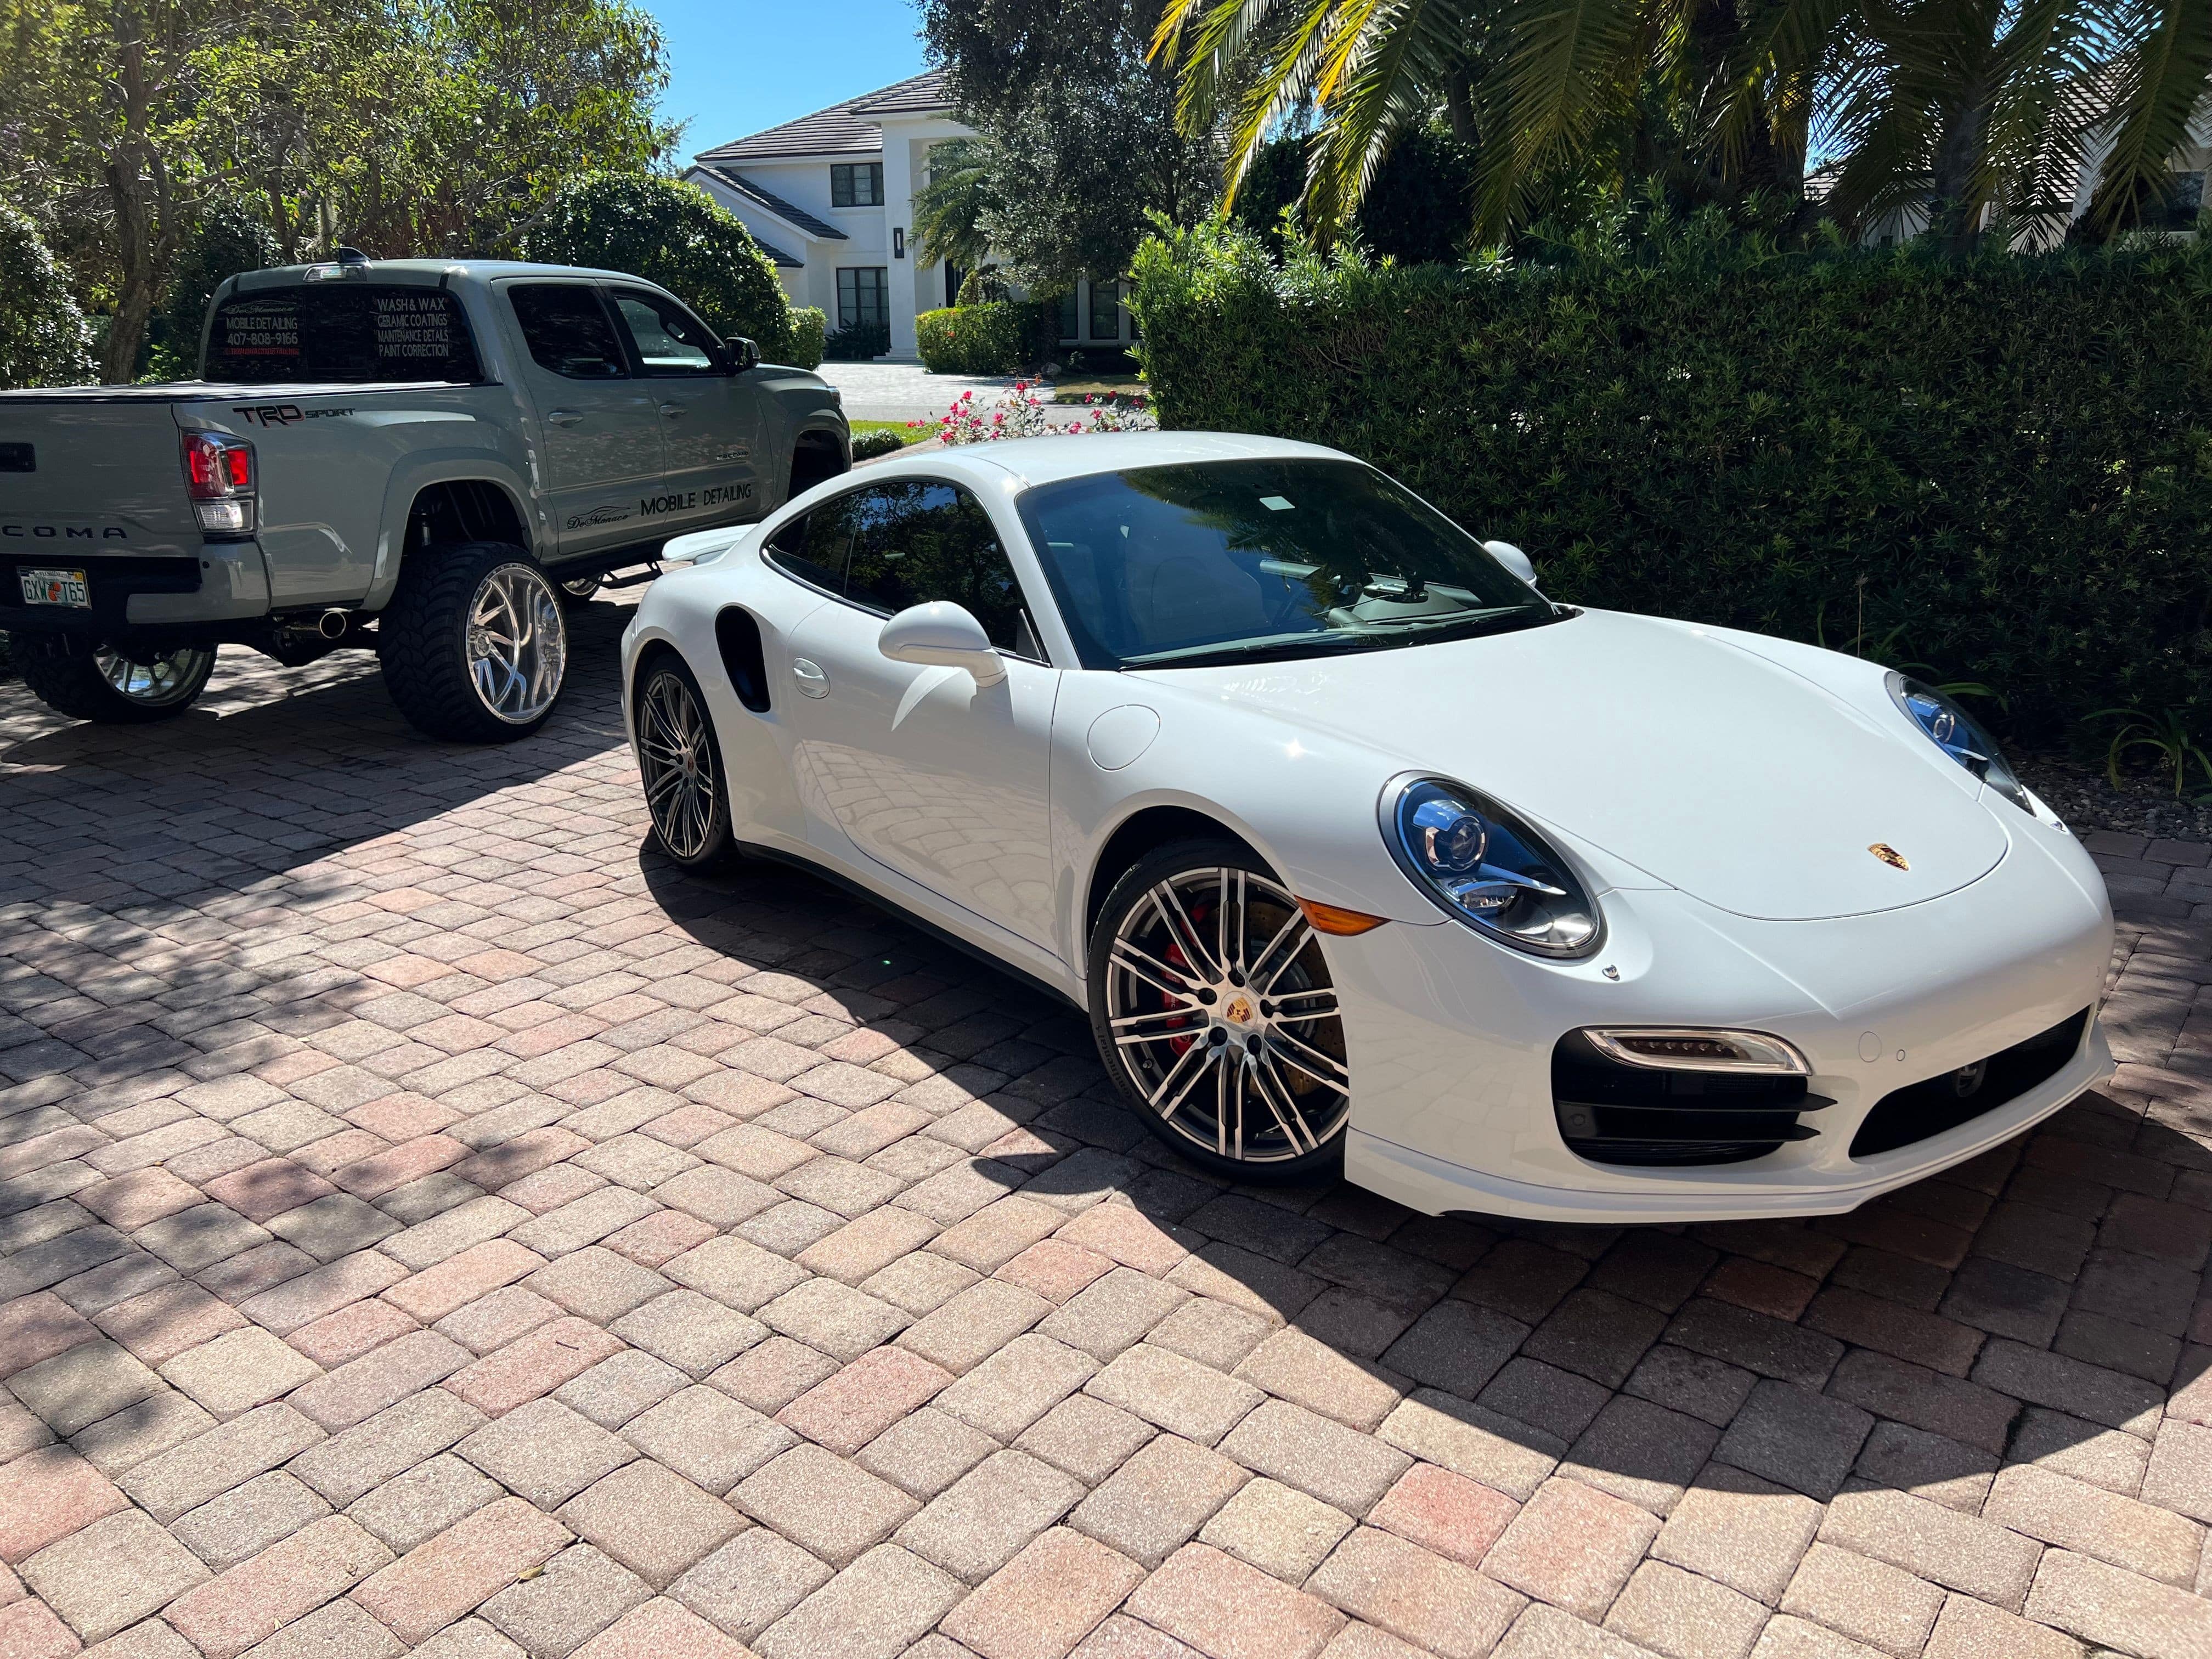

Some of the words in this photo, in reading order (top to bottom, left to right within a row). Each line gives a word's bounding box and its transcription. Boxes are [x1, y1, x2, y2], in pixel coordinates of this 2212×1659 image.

[377, 298, 408, 312] WASH
[419, 298, 445, 311] WAX
[226, 317, 255, 330] MOBILE
[256, 317, 298, 330] DETAILING
[377, 314, 409, 328] CERAMIC
[410, 313, 448, 327] COATINGS
[226, 331, 298, 346] 407-808-9166
[377, 329, 421, 343] MAINTENANCE
[422, 329, 449, 342] DETAILS
[379, 344, 400, 357] PAINT
[402, 344, 449, 357] CORRECTION
[232, 404, 304, 428] TRD
[305, 408, 356, 419] SPORT
[641, 492, 697, 516] MOBILE
[703, 483, 752, 506] DETAILING
[24, 579, 48, 601] GXW
[60, 581, 86, 602] T65
